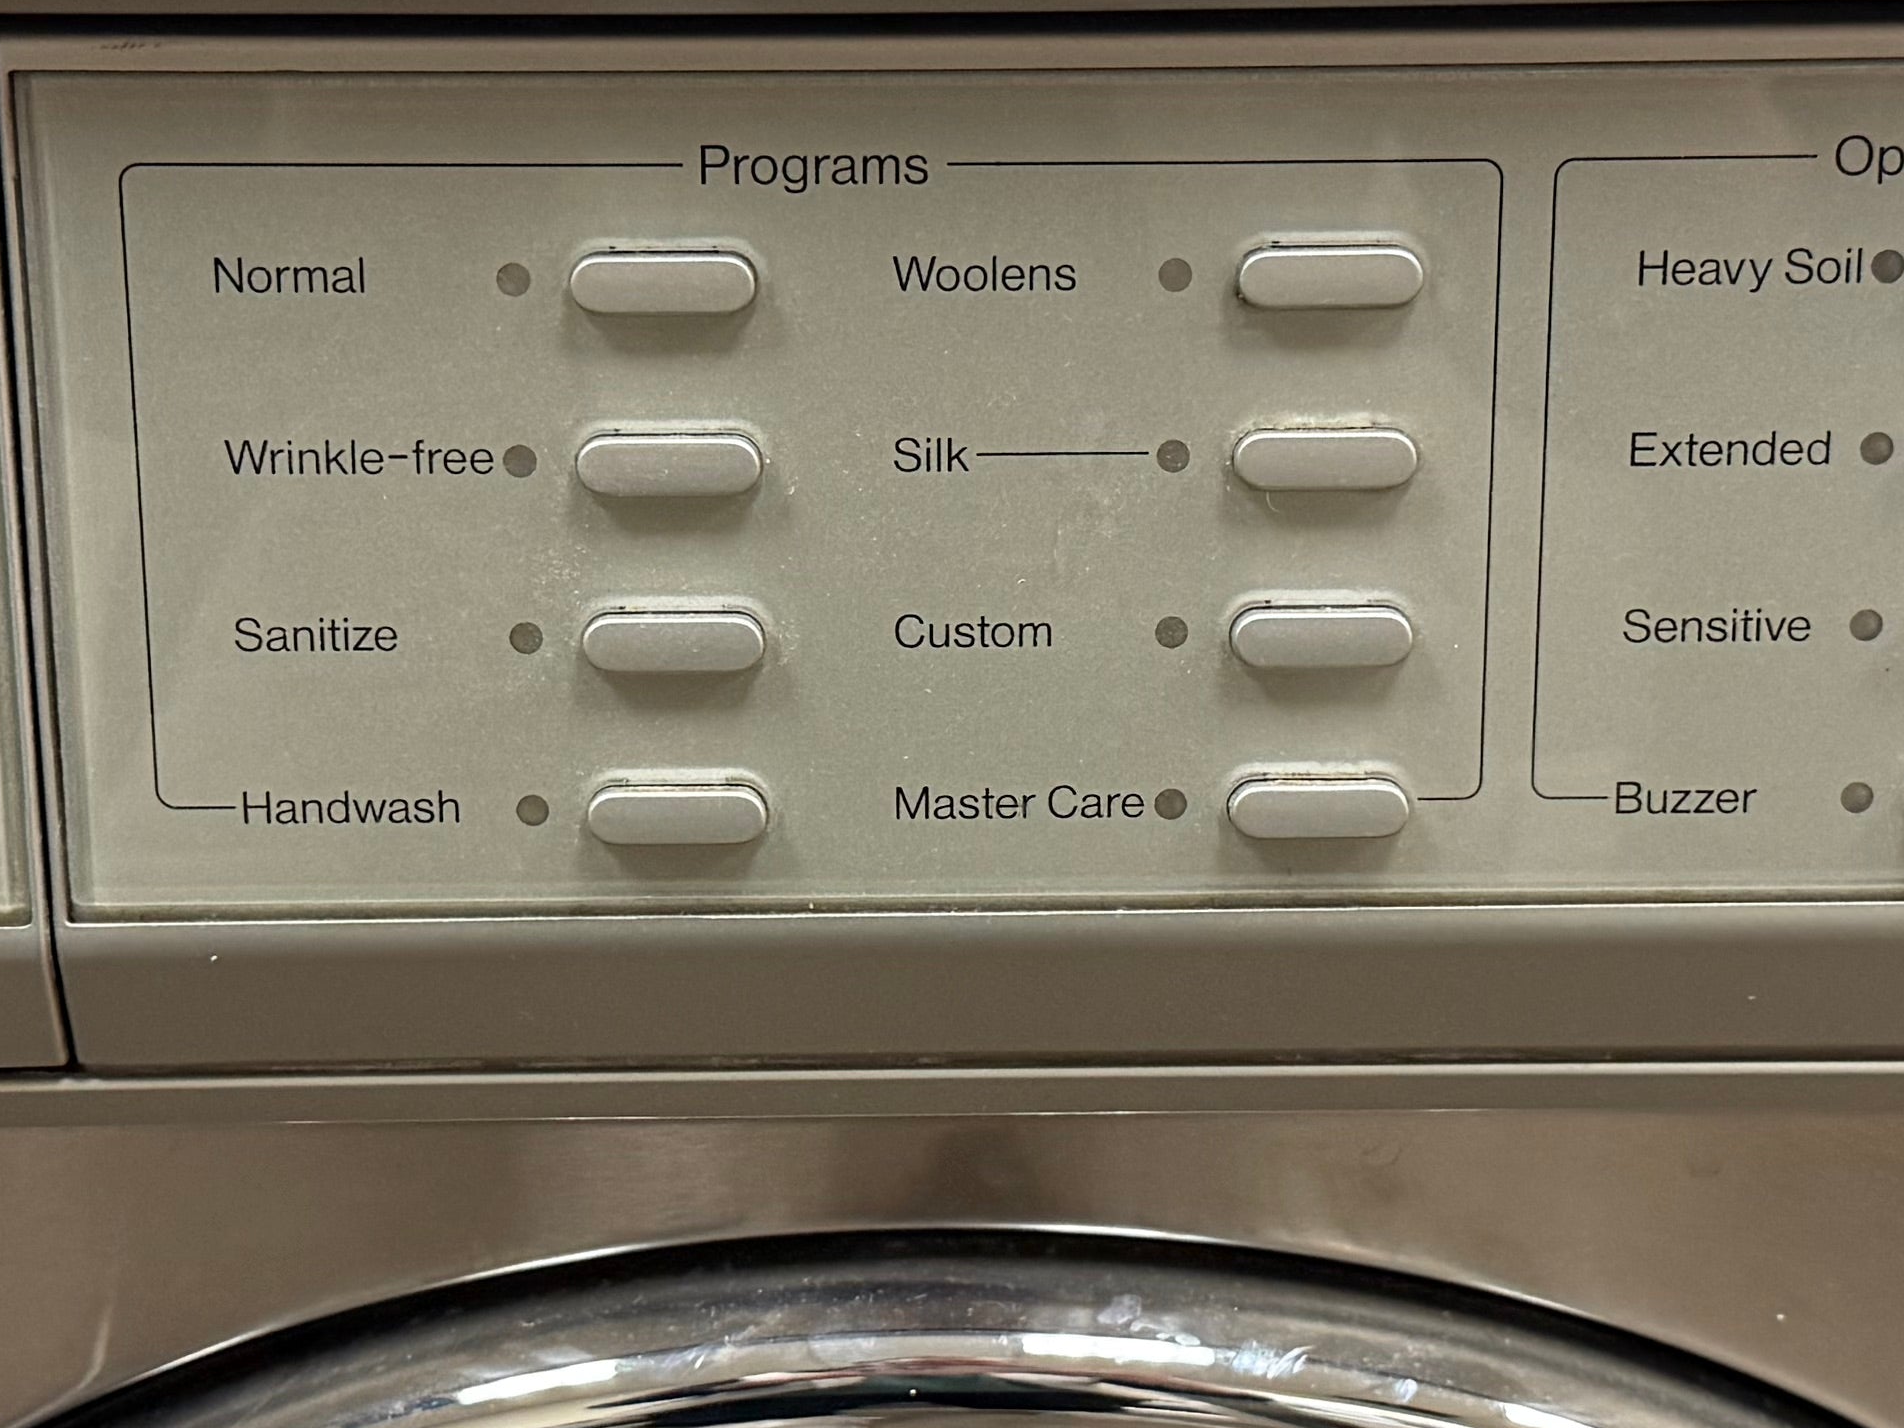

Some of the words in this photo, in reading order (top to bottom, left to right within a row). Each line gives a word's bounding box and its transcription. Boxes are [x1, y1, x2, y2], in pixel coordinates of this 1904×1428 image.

[698, 144, 930, 194] Programs
[211, 256, 367, 294] Normal
[892, 255, 1078, 292] Woolens
[1637, 249, 1773, 292] Heavy
[1784, 247, 1864, 286] Soil
[223, 438, 496, 476] Wrinkle-free
[892, 436, 970, 473] Silk
[1628, 430, 1833, 468] Extended
[233, 616, 399, 653] Sanitize
[893, 613, 1053, 650] Custom
[1621, 607, 1812, 644] Sensitive
[241, 789, 462, 825] Handwash
[893, 785, 1036, 820] Master
[1046, 785, 1146, 820] Care
[1613, 780, 1758, 815] Buzzer
